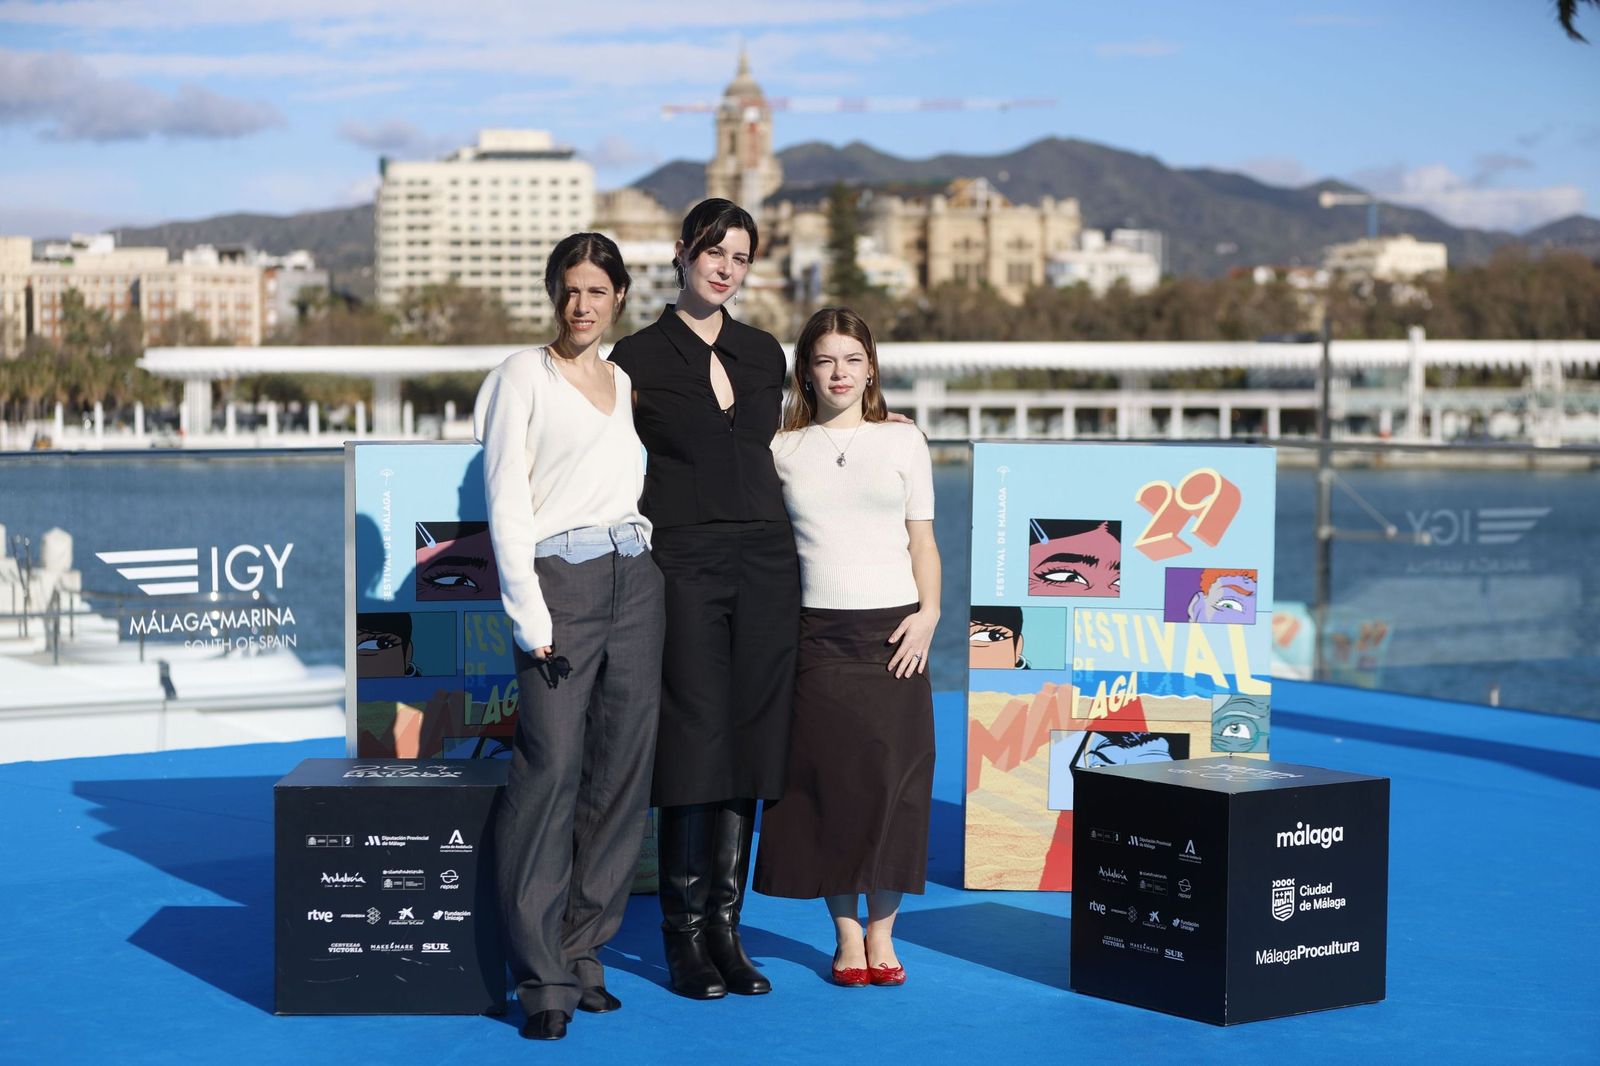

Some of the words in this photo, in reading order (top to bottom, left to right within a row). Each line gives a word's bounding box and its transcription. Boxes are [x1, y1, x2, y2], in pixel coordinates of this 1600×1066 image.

[1133, 468, 1241, 561] 29
[997, 531, 1006, 544] DE
[211, 543, 294, 592] IGY
[996, 548, 1006, 597] FESTIVAL
[129, 610, 214, 635] MÁLAGA
[219, 607, 296, 628] MARINA
[184, 637, 232, 651] SOUTH
[236, 636, 256, 650] OF
[259, 634, 297, 649] SPAIN
[1074, 608, 1272, 696] FESTIVAL
[320, 871, 367, 884] Andalucía
[1299, 882, 1333, 897] Ciudad
[1089, 900, 1106, 915] rtve
[1299, 900, 1312, 911] de
[1313, 897, 1347, 910] Málaga
[307, 909, 334, 923] rtve
[422, 942, 450, 950] SUR
[1102, 938, 1125, 949] VICTORIA
[1165, 948, 1184, 959] SUR
[1255, 941, 1360, 965] MálagaProcultura
